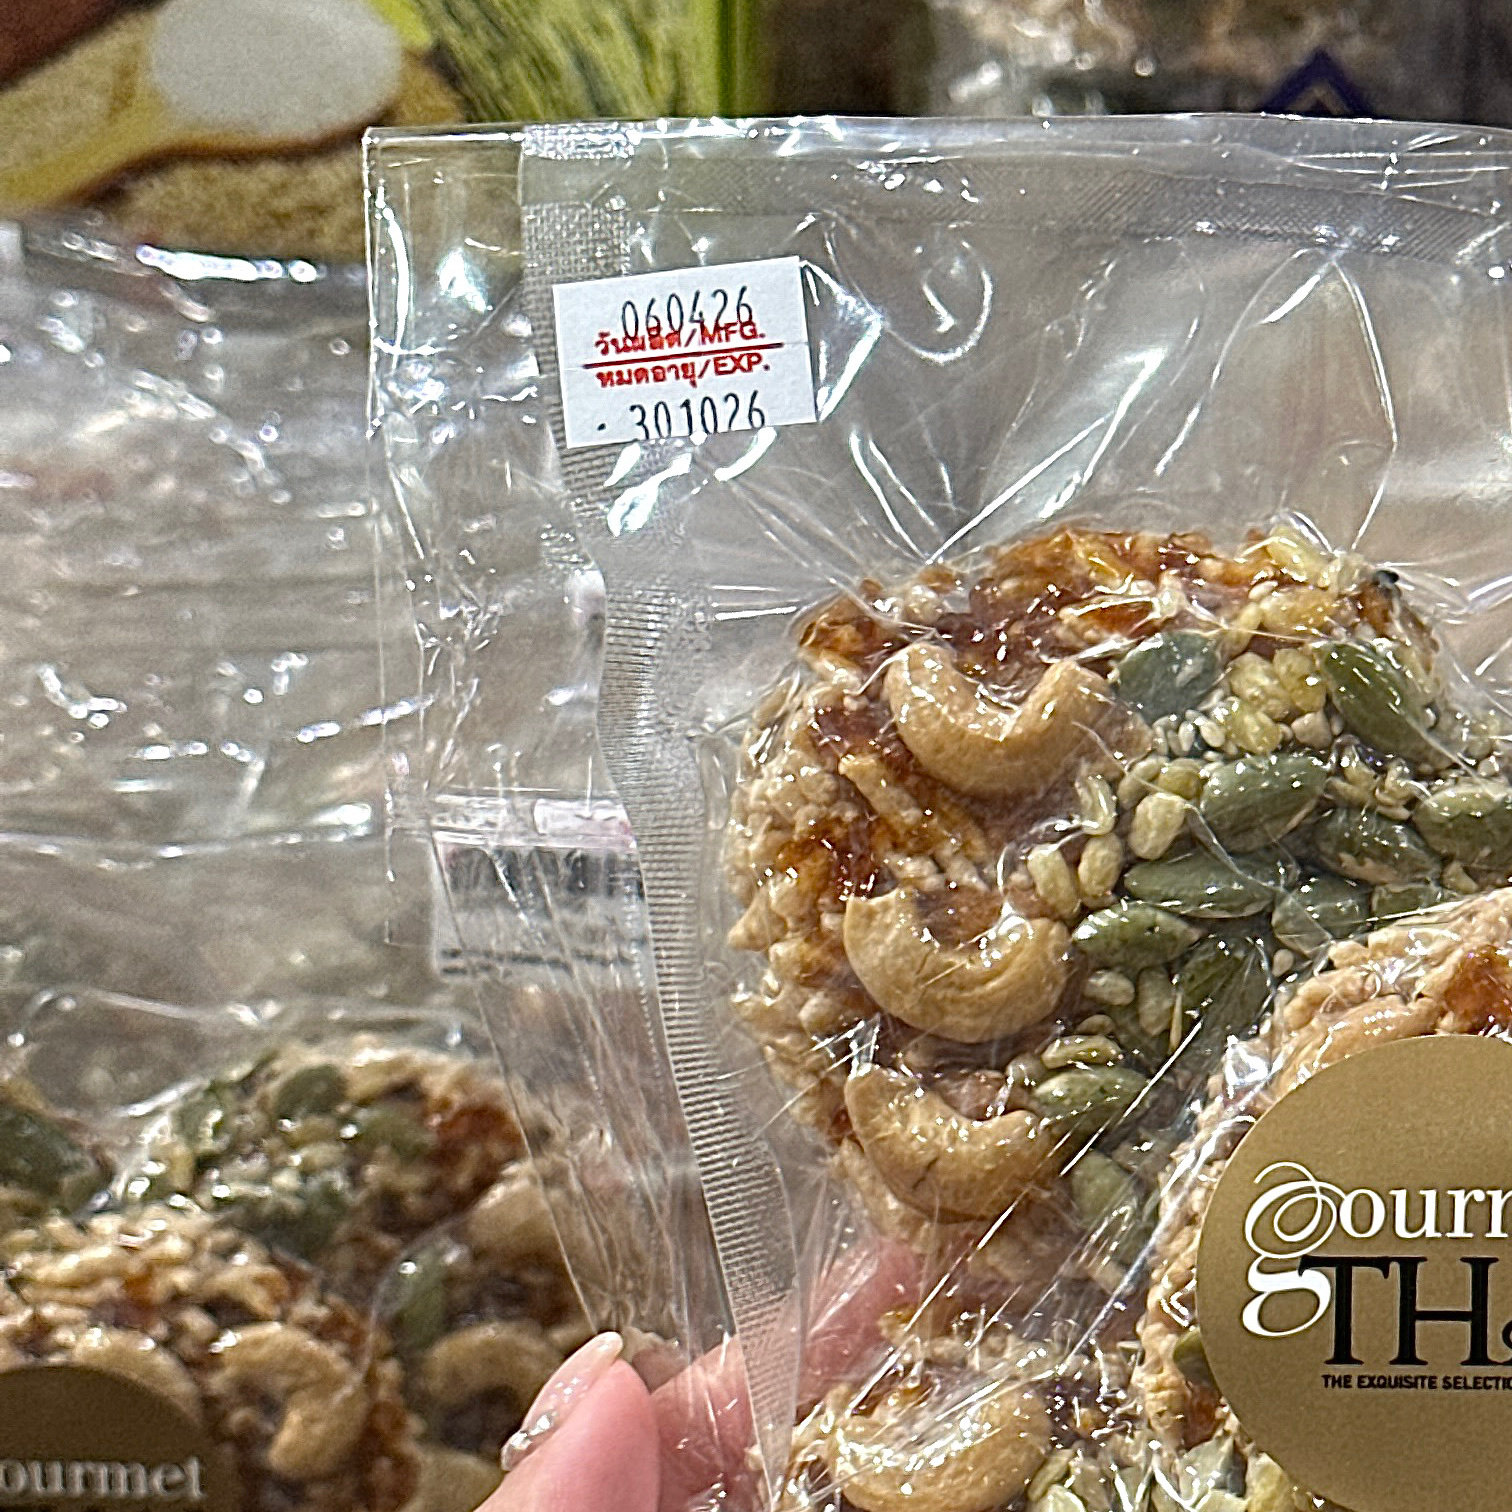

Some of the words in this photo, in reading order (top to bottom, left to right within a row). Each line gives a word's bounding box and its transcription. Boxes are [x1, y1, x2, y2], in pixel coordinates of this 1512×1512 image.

[622, 286, 752, 340] 060426
[595, 352, 770, 388] หมดอายุ/EXP.
[630, 390, 765, 440] 301026
[1322, 1375, 1352, 1389] THE
[1357, 1375, 1437, 1390] EXQUISITE
[0, 1456, 206, 1498] ourmet
